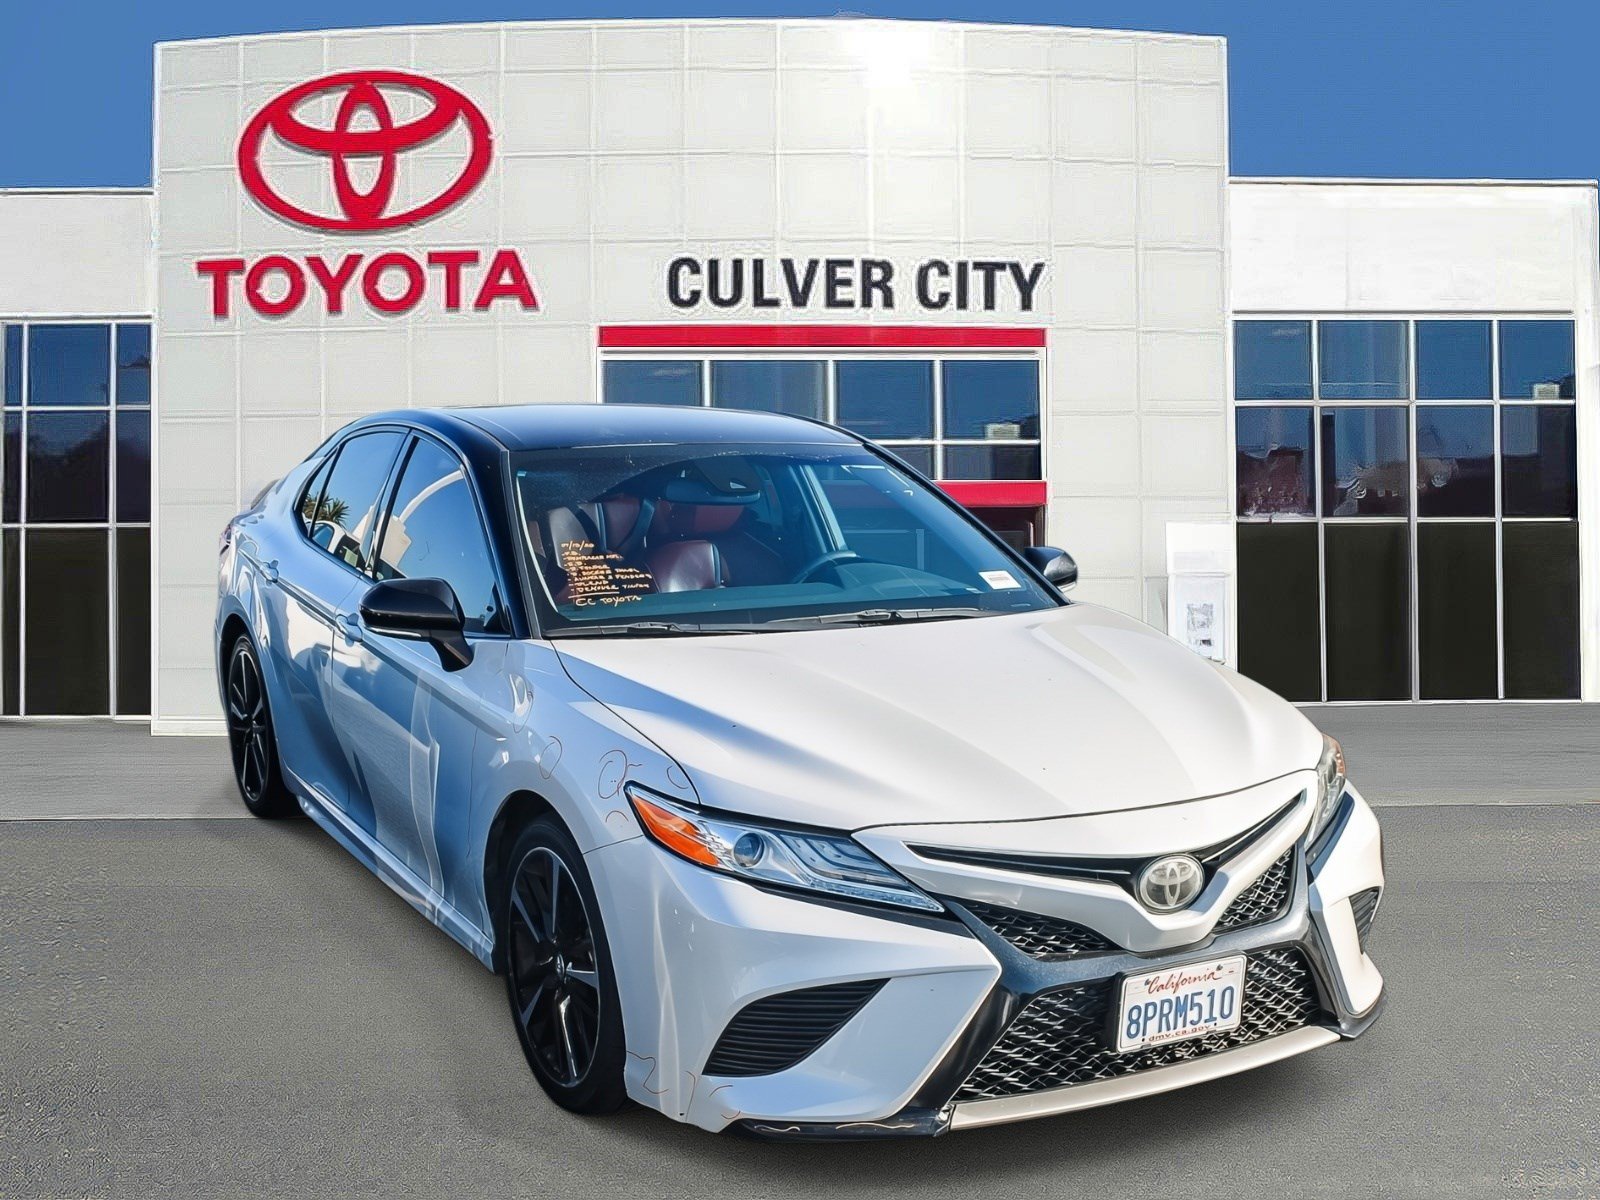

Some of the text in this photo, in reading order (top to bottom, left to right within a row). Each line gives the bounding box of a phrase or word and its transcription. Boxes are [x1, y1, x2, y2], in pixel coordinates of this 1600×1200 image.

[195, 250, 540, 319] TOYOTA
[667, 256, 1046, 311] CULVER CITY
[575, 595, 642, 607] CC TOYOTA
[1147, 968, 1222, 994] California
[1126, 985, 1235, 1039] 8PRM510
[1148, 1025, 1211, 1041] dmv.ca.gov
